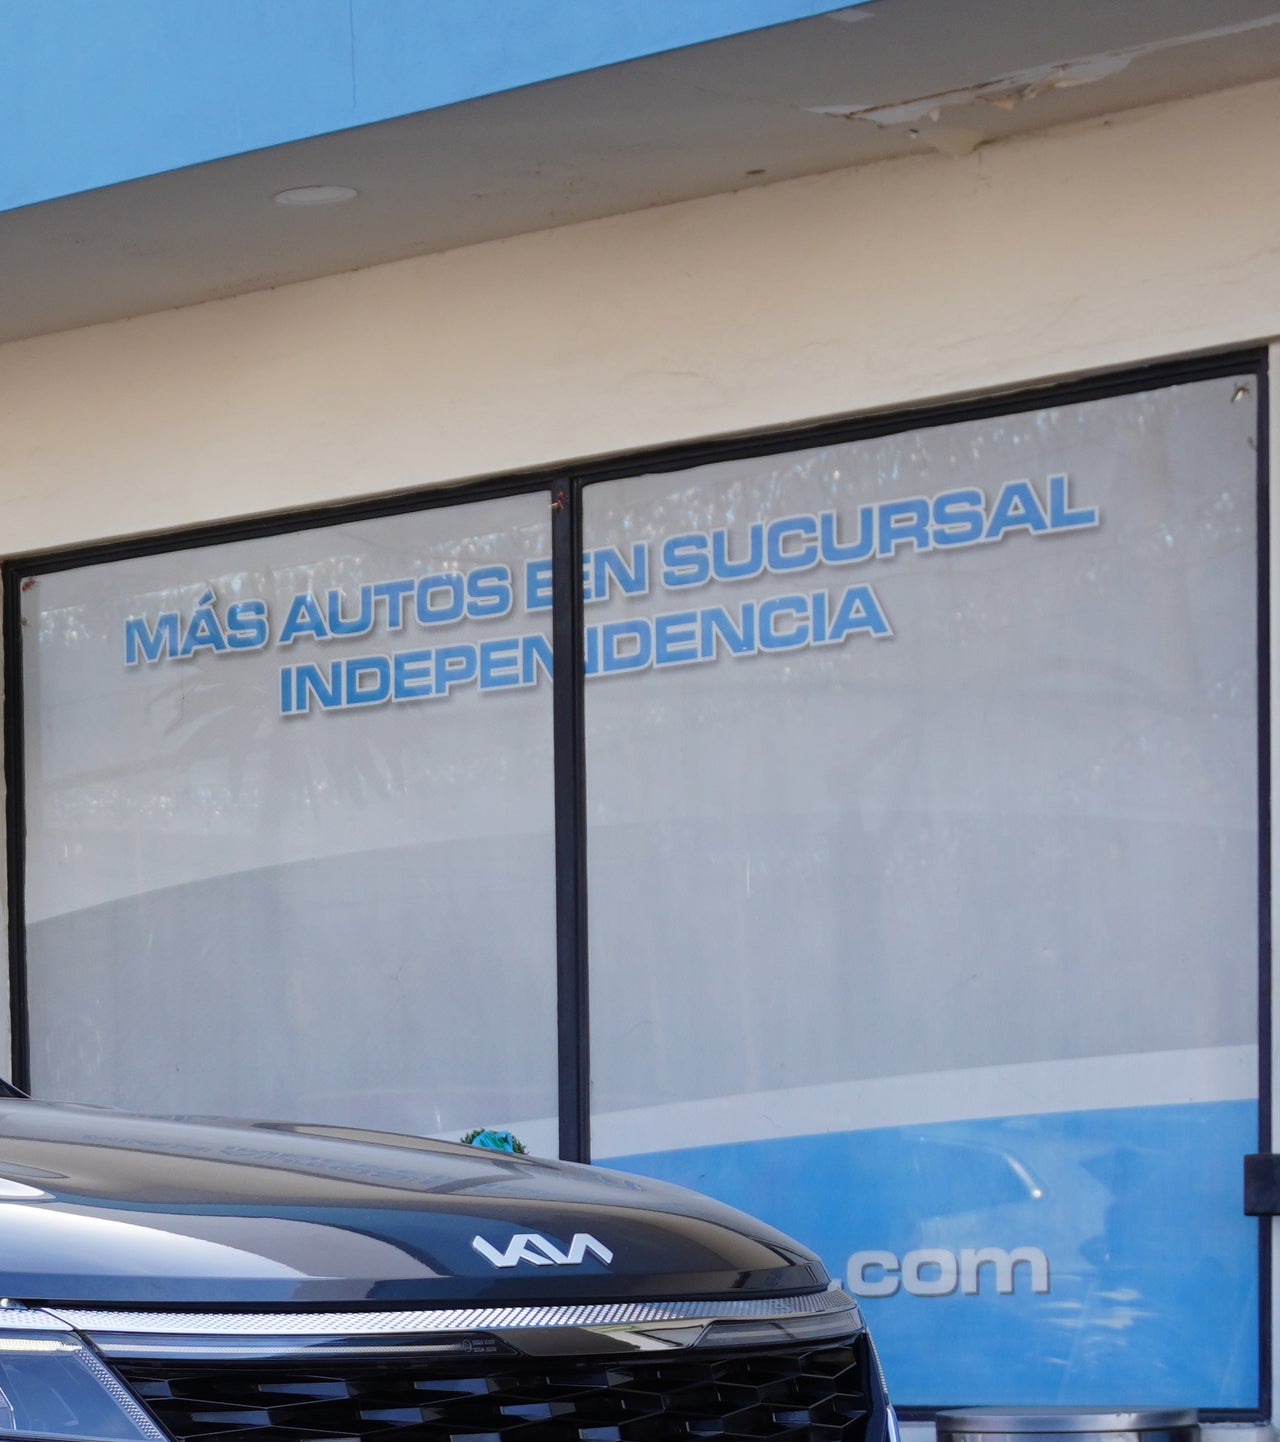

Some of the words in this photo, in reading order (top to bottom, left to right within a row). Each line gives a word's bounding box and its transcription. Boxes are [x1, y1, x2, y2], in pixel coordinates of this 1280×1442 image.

[124, 589, 269, 668] MÁS
[278, 565, 513, 646] AUTOS
[526, 541, 649, 612] EN
[661, 473, 1100, 590] SUCURSAL
[278, 582, 894, 717] INDEPENDENCIA
